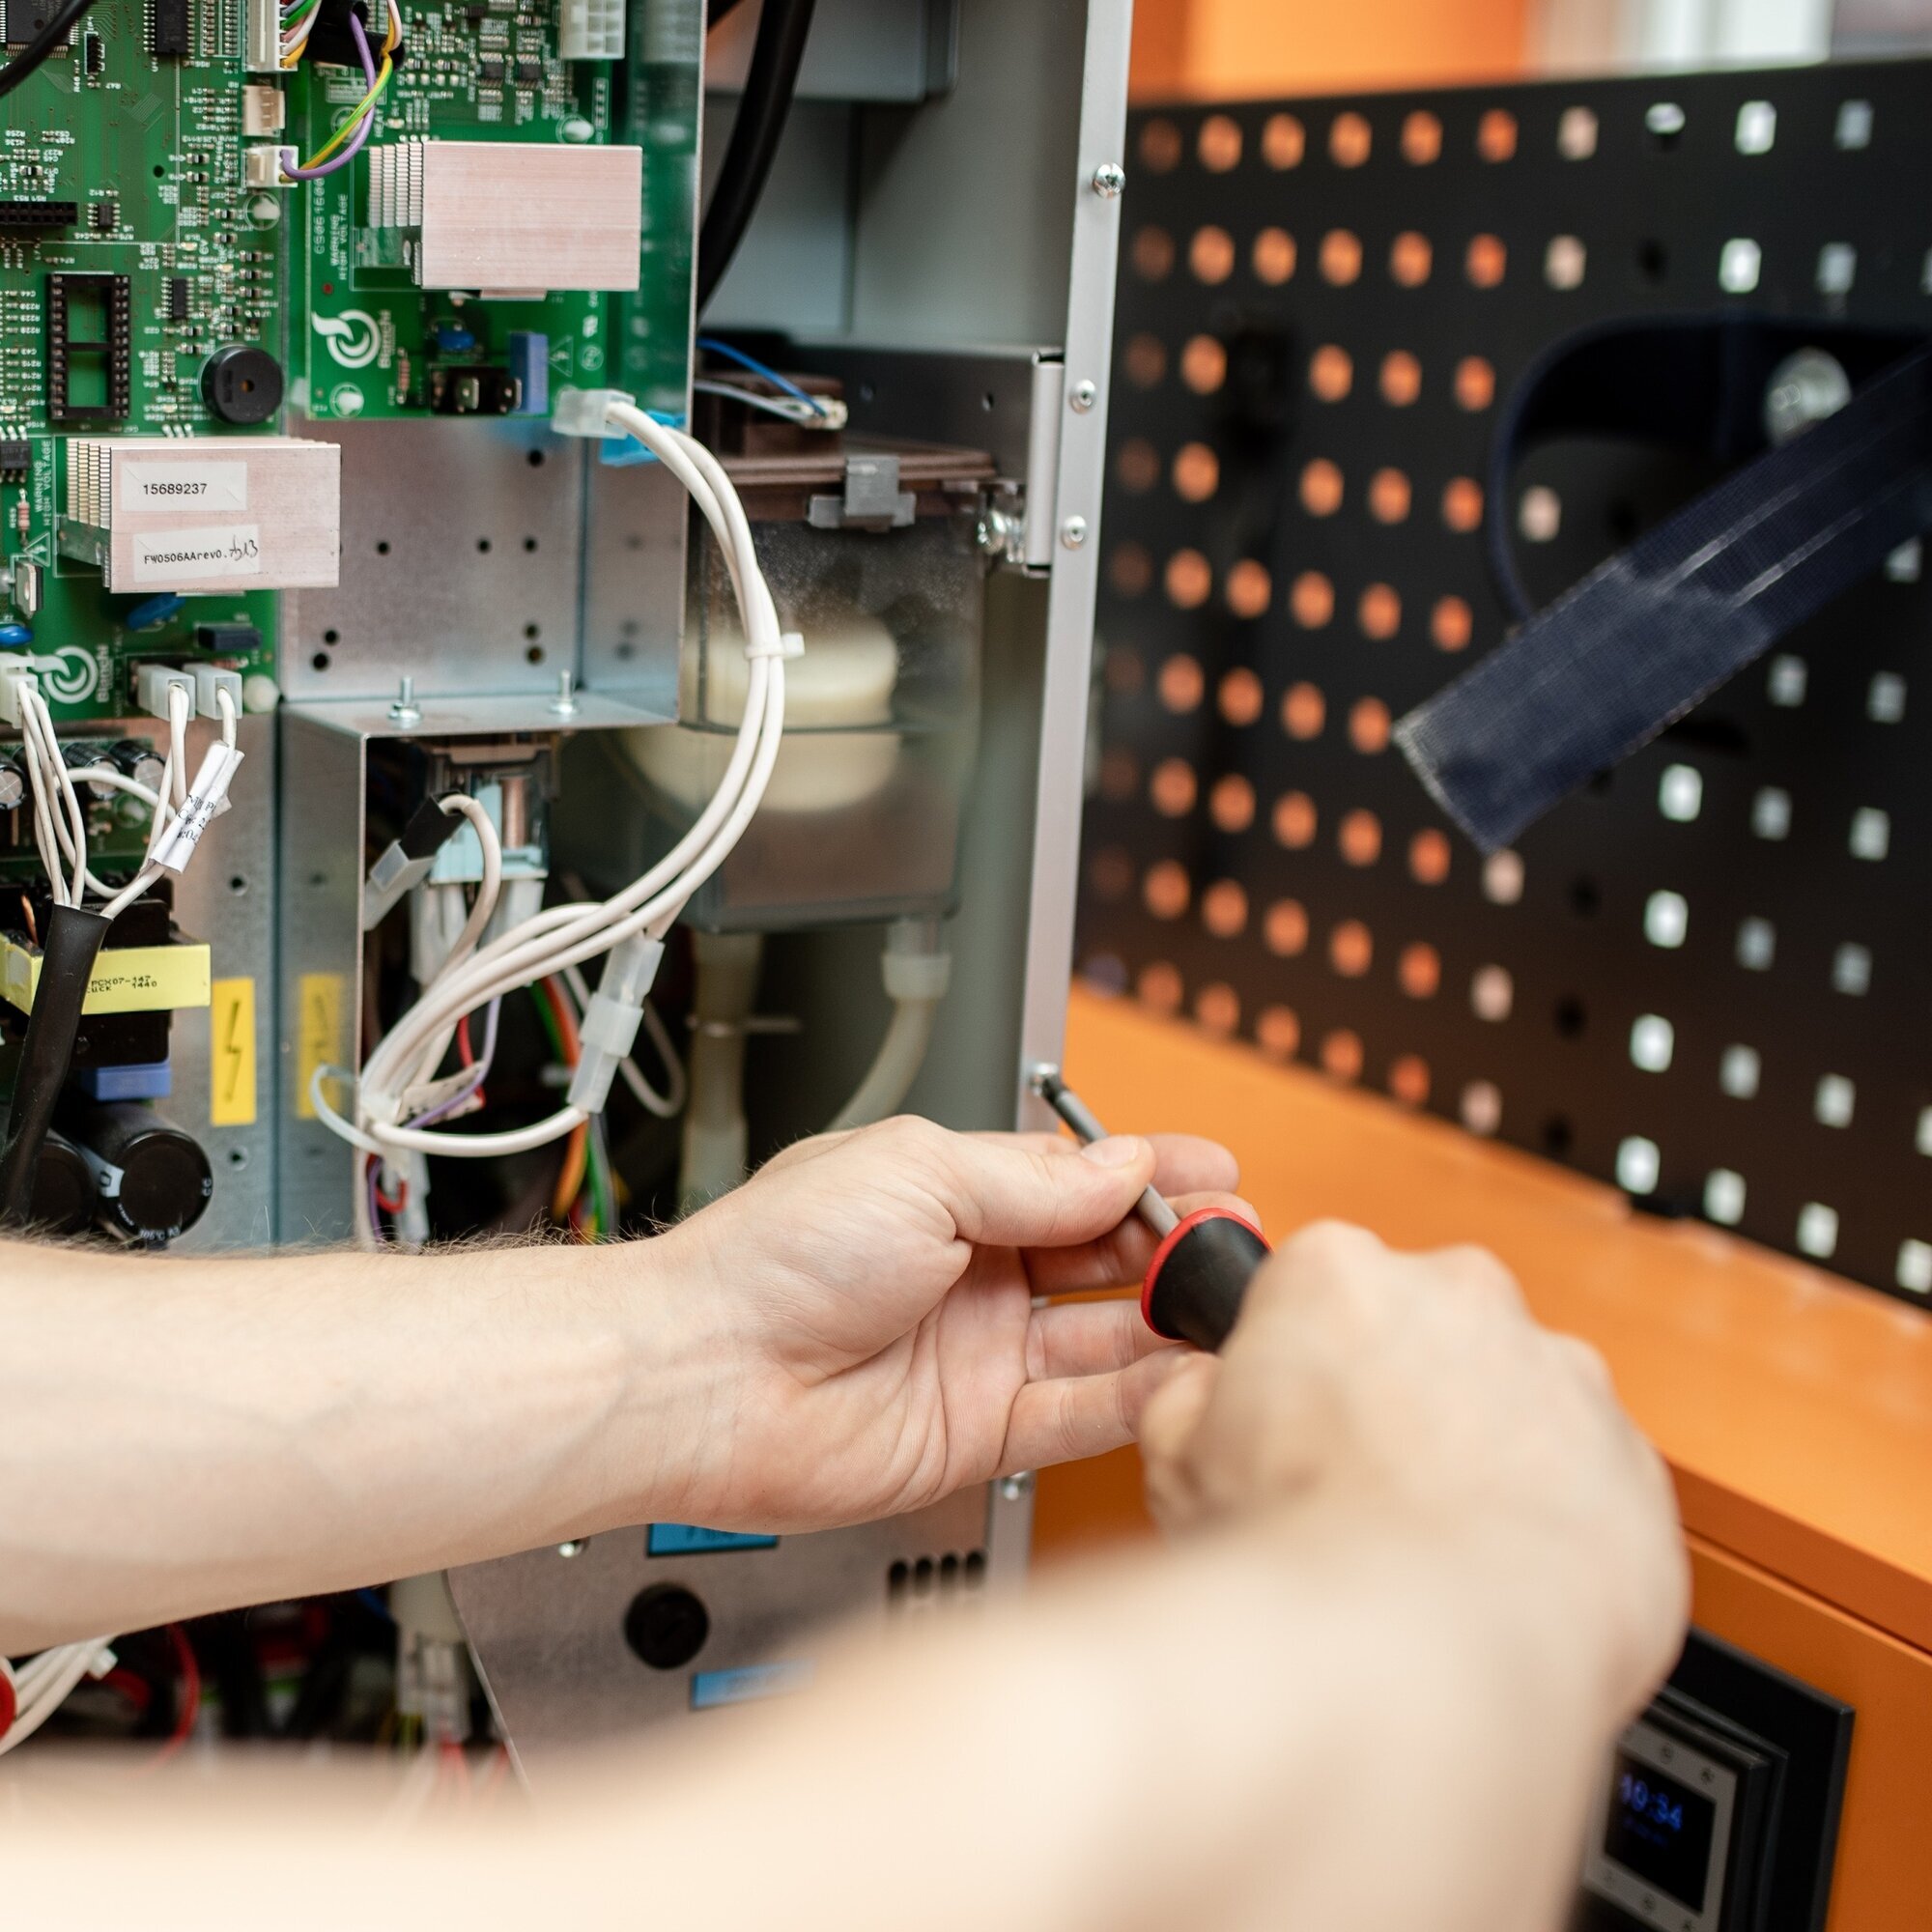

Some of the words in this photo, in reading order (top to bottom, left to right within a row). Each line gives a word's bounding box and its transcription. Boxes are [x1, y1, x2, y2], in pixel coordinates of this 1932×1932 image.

[329, 213, 340, 267] WARNING
[338, 194, 348, 243] VOLTAGE
[338, 250, 348, 280] HIGH
[34, 460, 43, 513] WARNING
[42, 440, 51, 491] VOLTAGE
[143, 483, 208, 495] 15689237
[43, 497, 51, 526] HIGH
[96, 643, 110, 703] Bianchi
[131, 980, 157, 990] 1440
[1621, 1774, 1683, 1832] 10:34
